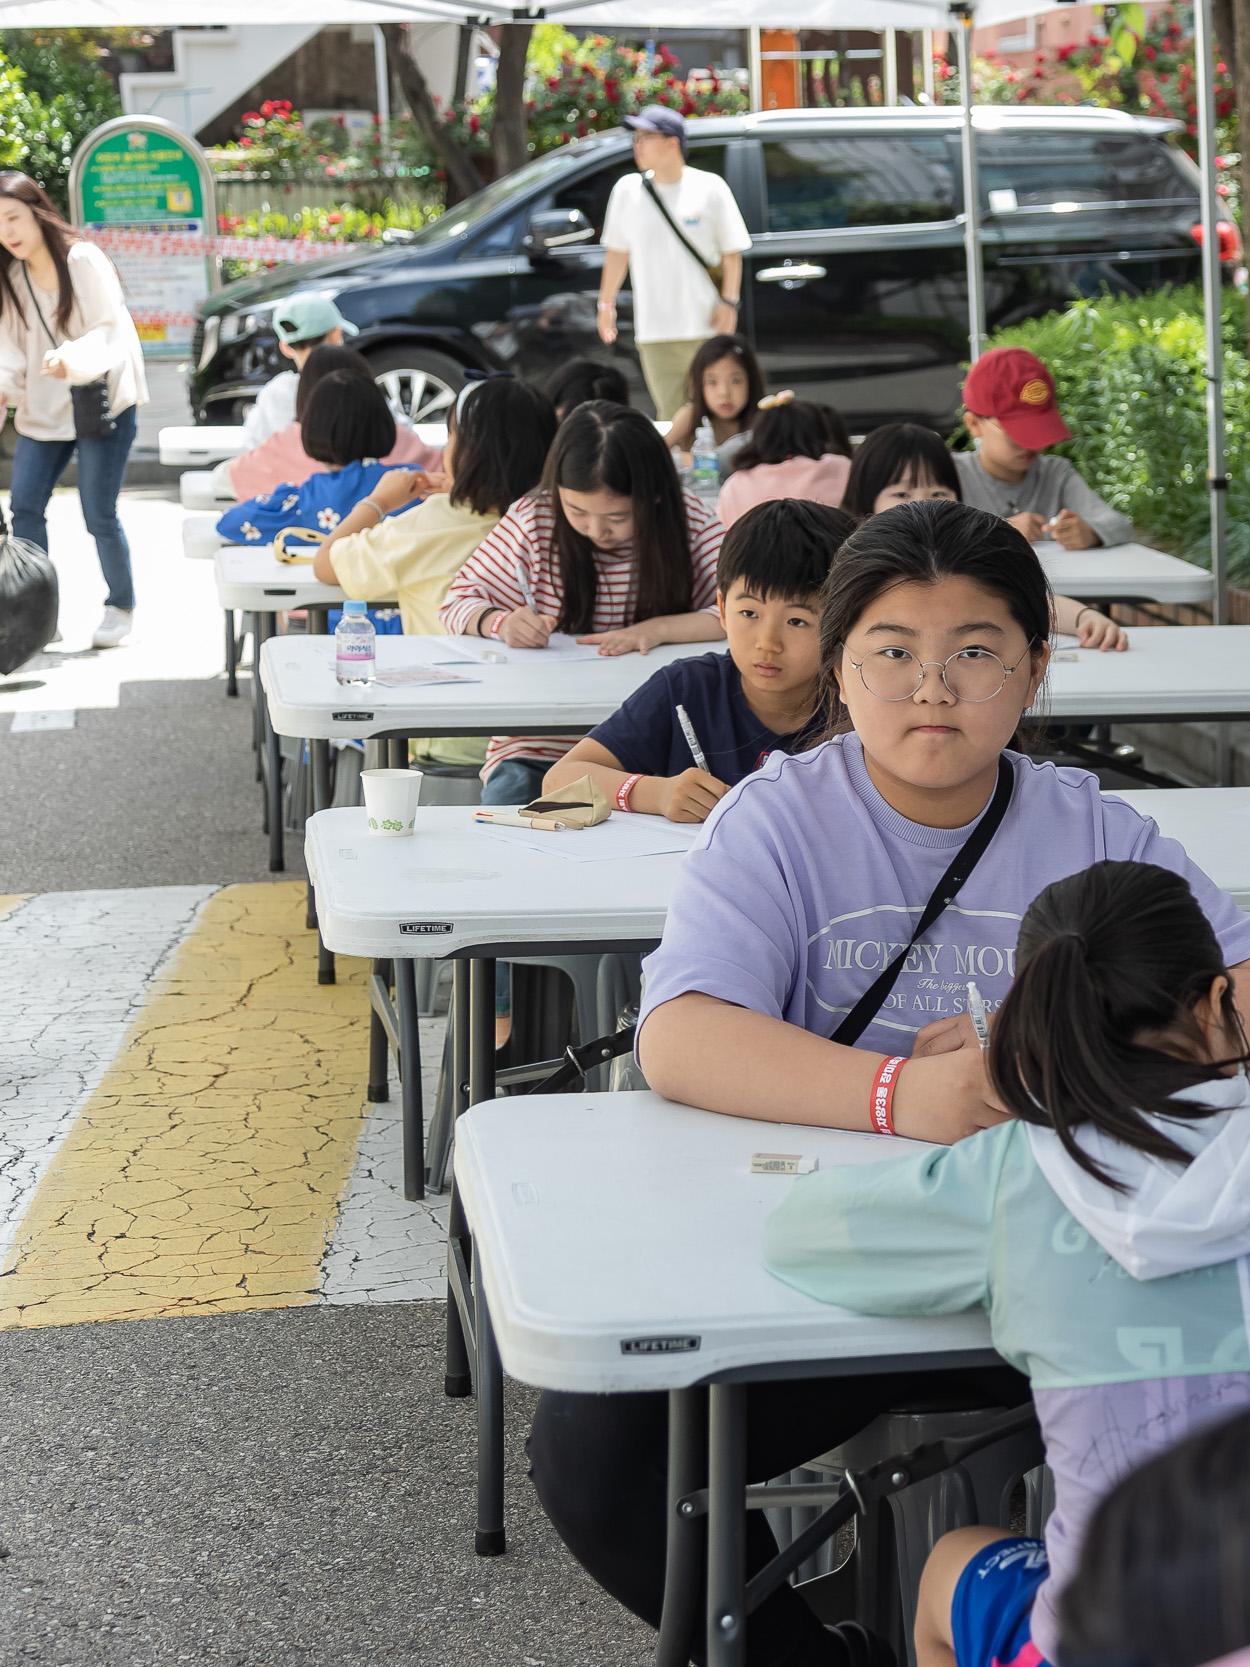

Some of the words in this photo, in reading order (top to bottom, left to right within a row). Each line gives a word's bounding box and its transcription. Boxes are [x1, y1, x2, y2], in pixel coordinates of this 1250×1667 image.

[917, 978, 939, 990] The
[883, 993, 907, 1009] OF
[912, 994, 948, 1013] ALL
[875, 1086, 888, 1127] 자양3동
